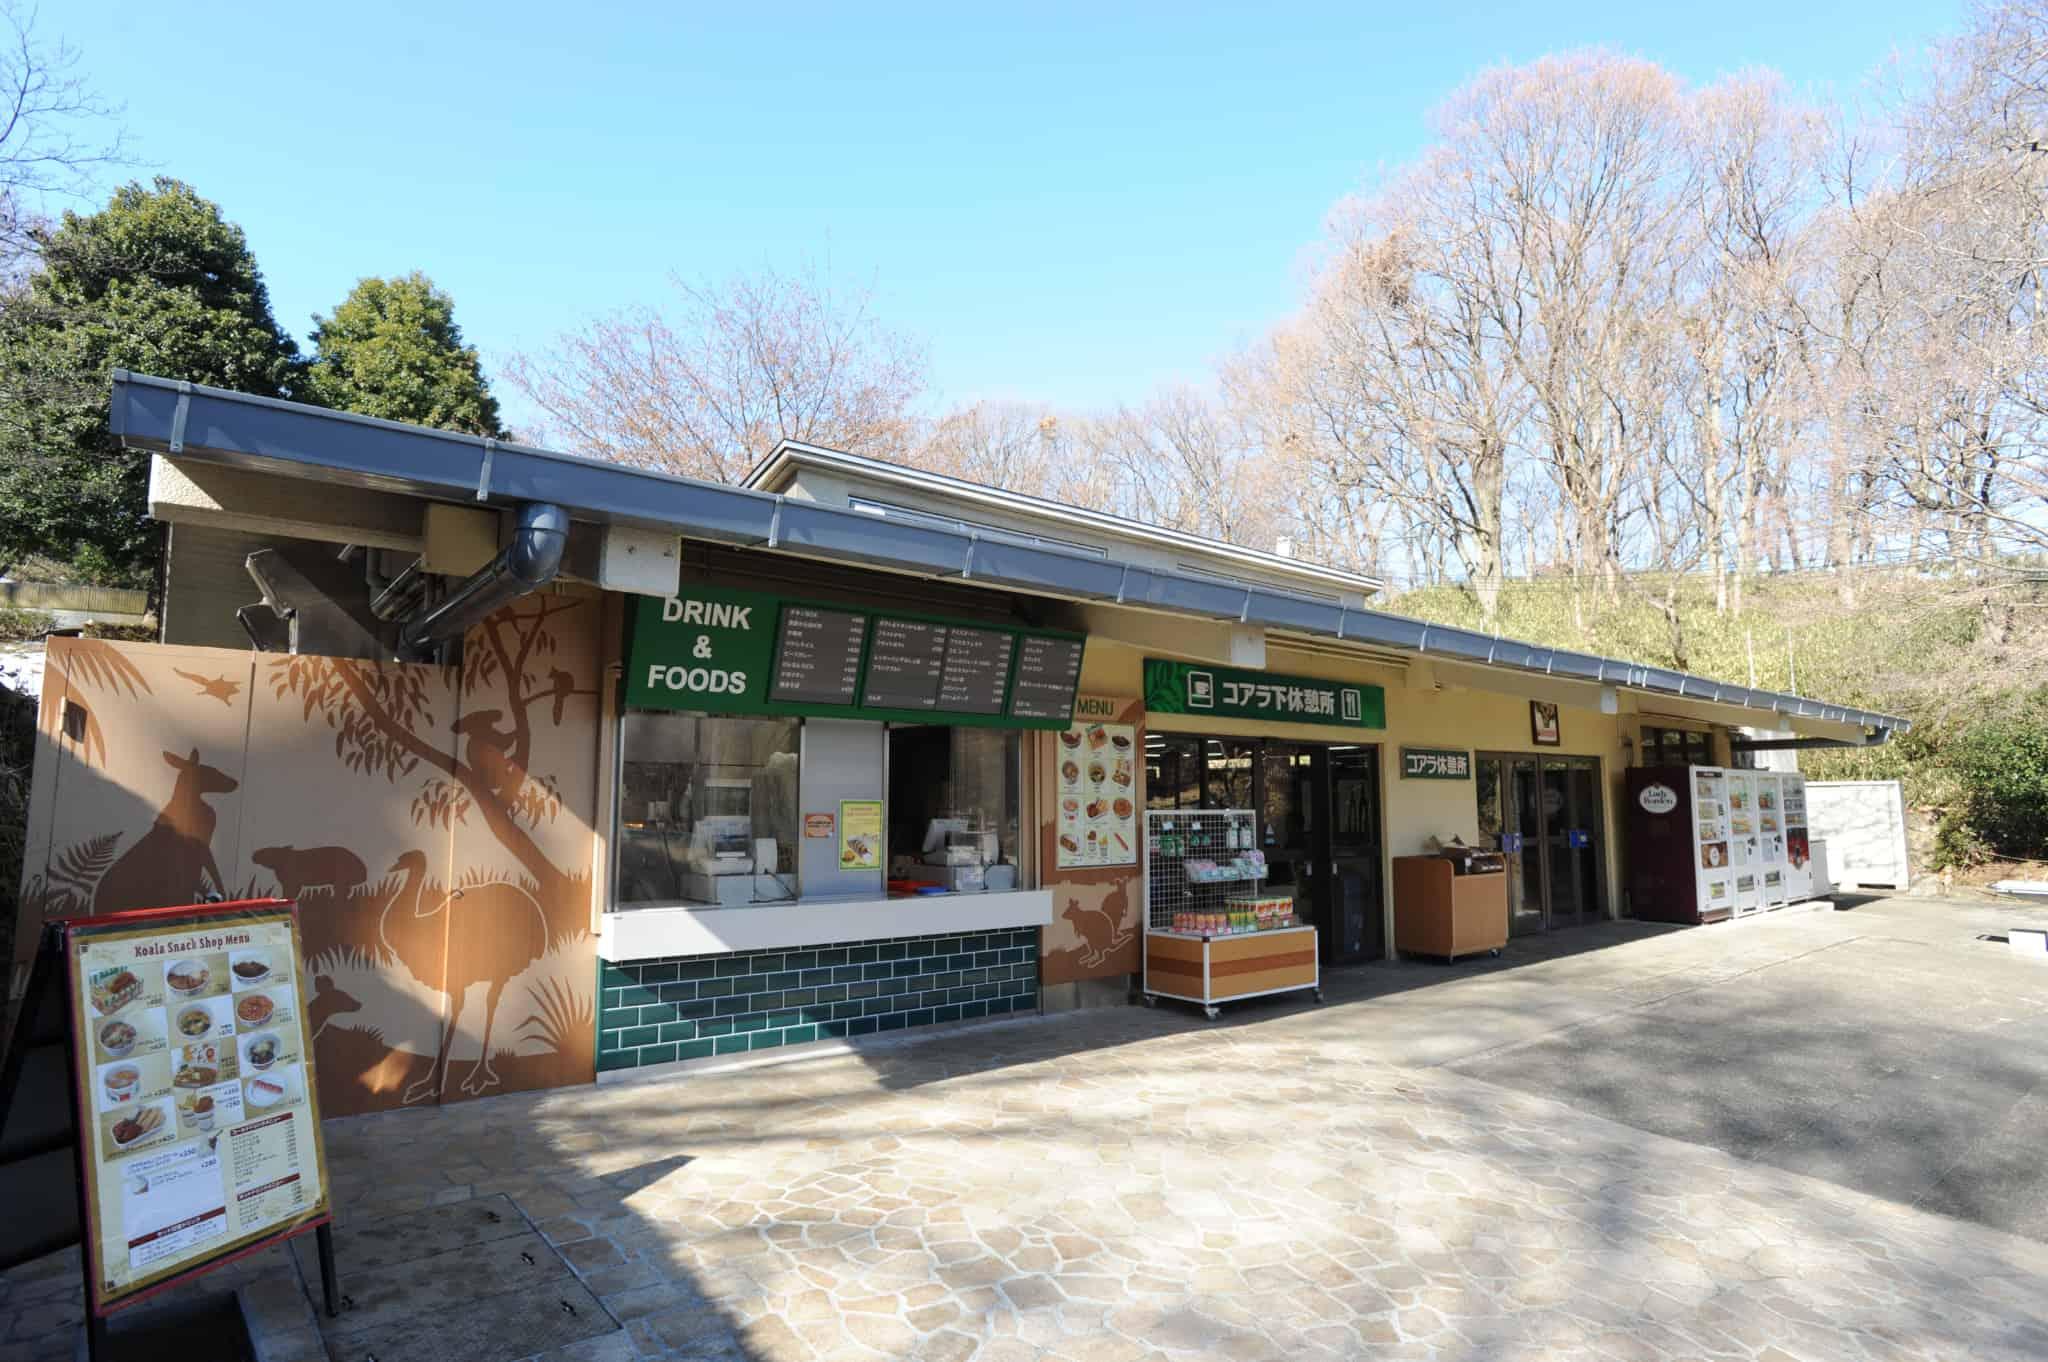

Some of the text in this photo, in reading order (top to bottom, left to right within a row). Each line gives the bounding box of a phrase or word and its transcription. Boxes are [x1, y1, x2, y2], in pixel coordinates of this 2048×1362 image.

[662, 598, 752, 630] DRINK
[692, 635, 713, 660] &
[647, 664, 748, 695] FOODS
[1077, 699, 1115, 717] MENU
[1221, 681, 1336, 716] コアラ下休憩所
[134, 933, 251, 958] Koala Snack Shop Menu
